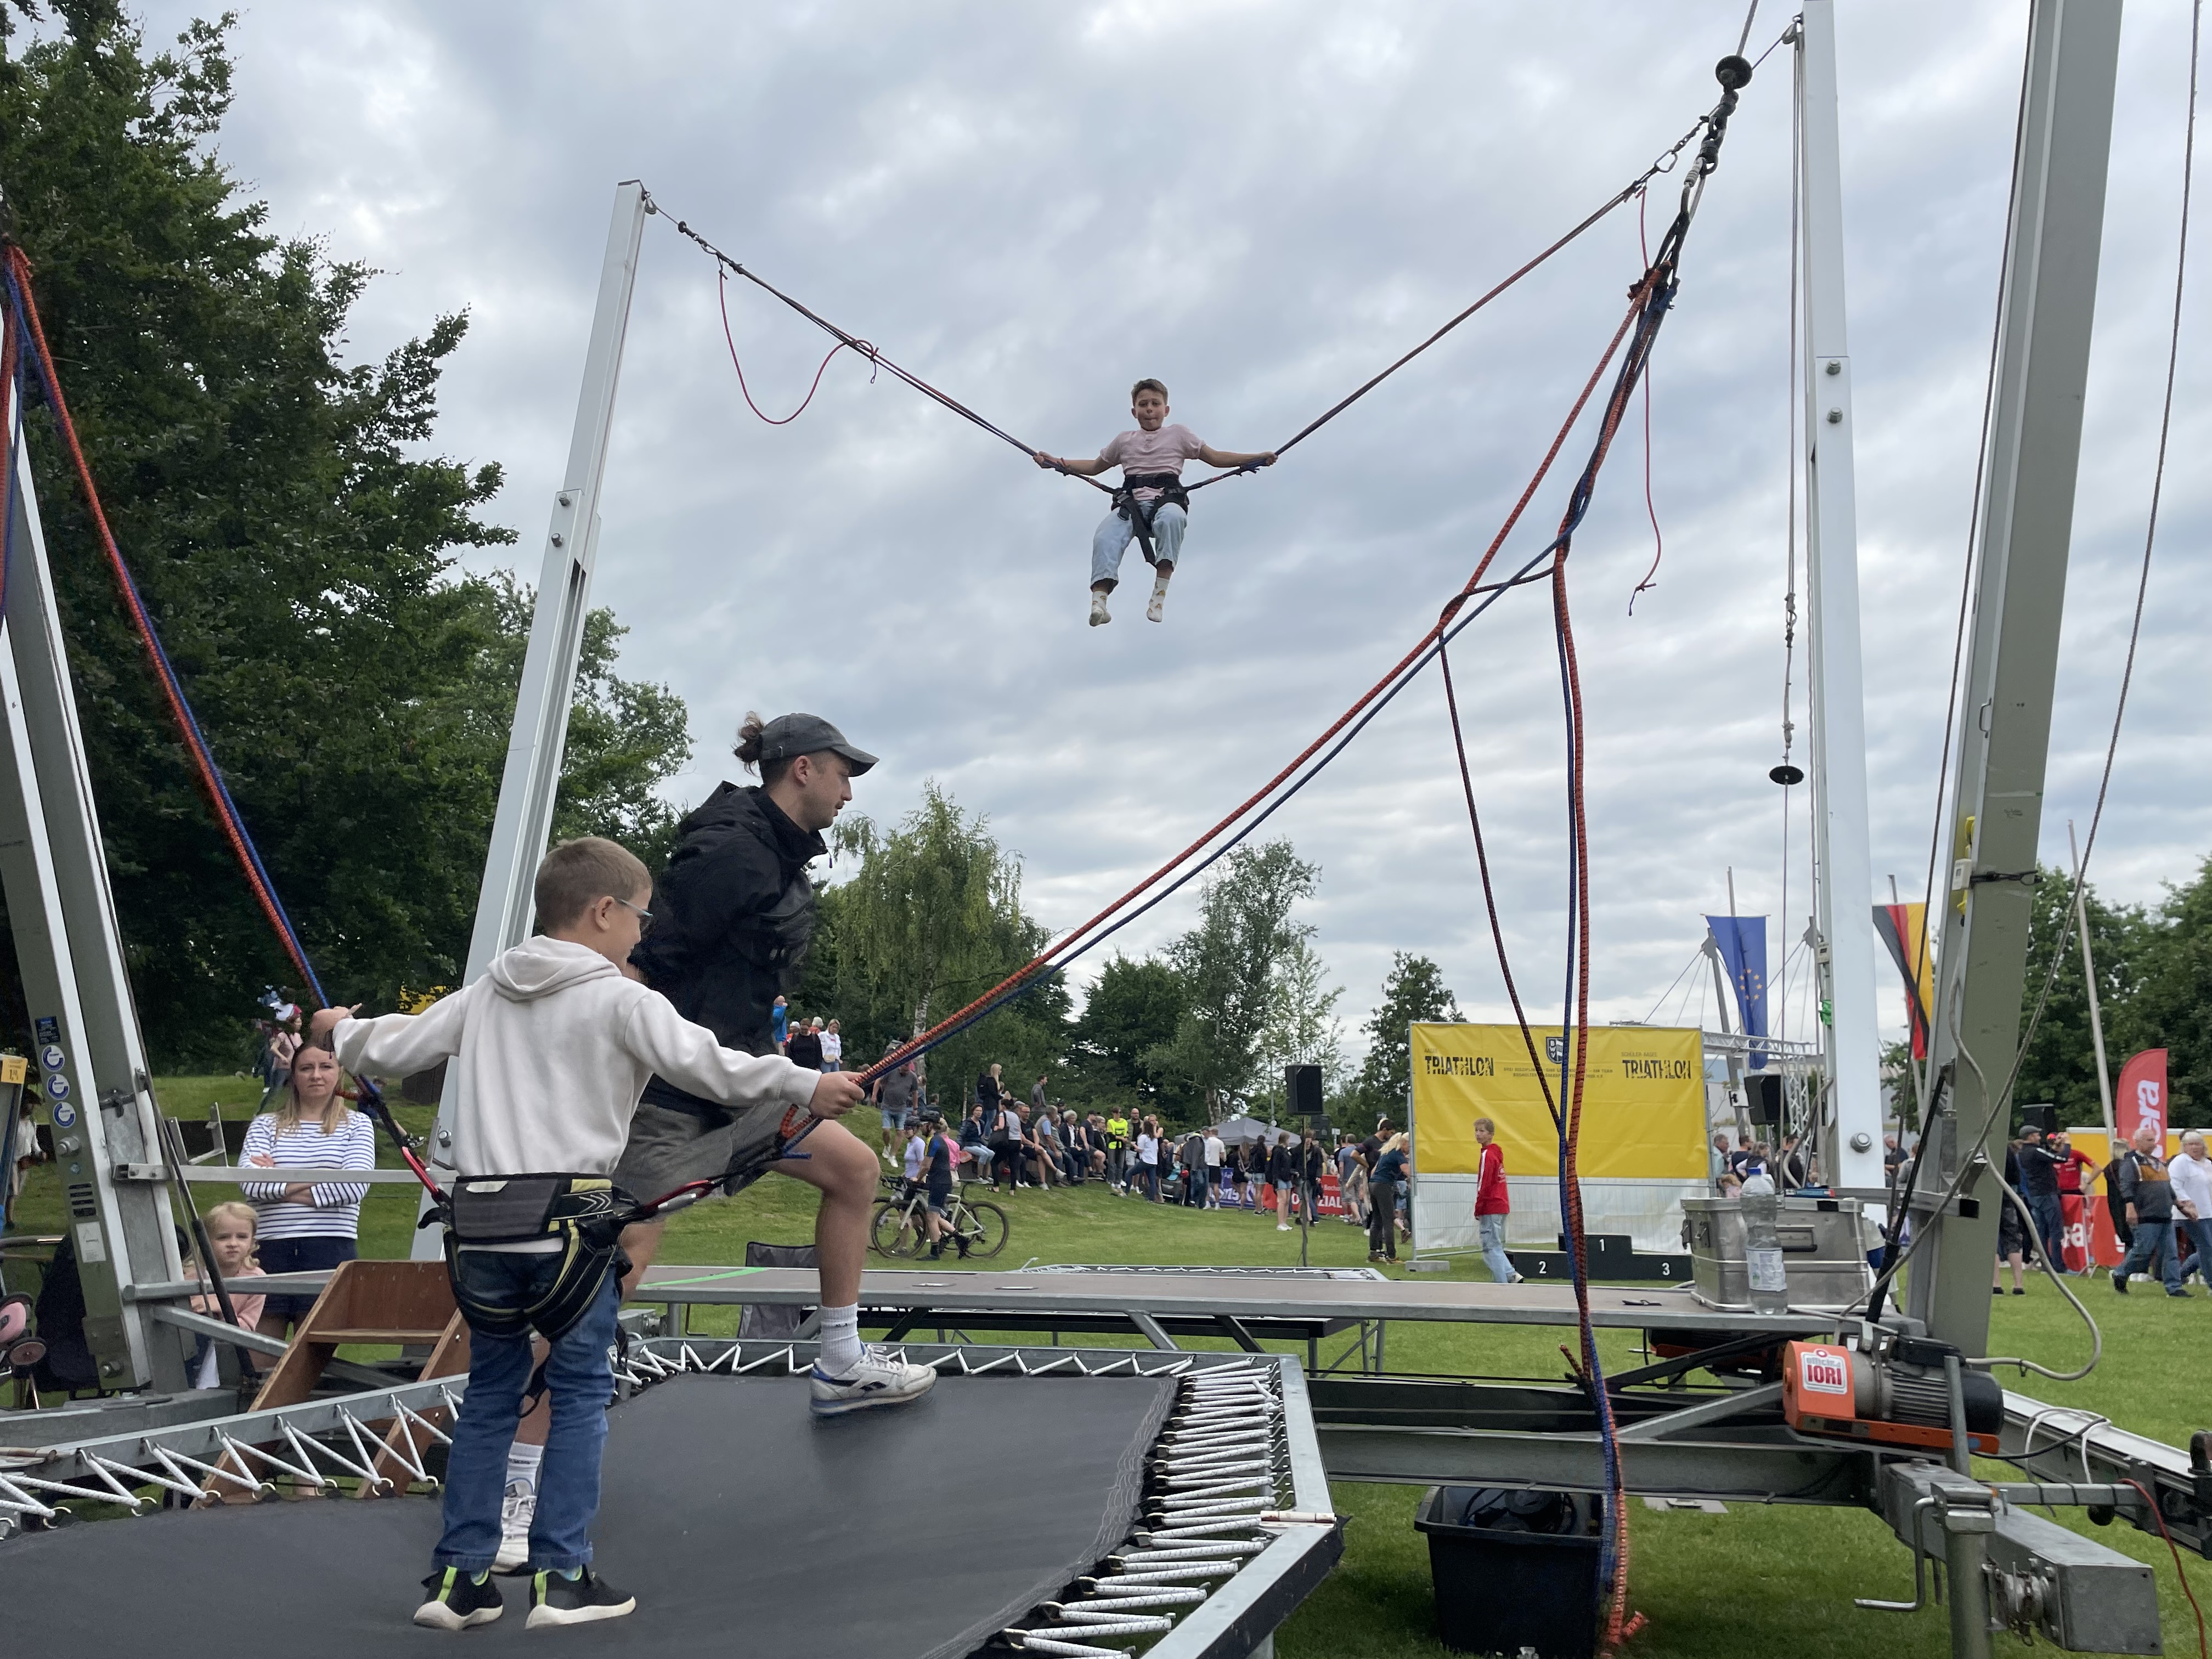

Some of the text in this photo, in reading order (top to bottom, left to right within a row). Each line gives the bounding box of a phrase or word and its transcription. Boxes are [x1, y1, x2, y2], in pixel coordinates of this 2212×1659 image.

[1425, 1056, 1494, 1076] TRIATHLON
[1622, 1059, 1691, 1079] TRIATHLON
[1599, 1238, 1605, 1252] 1
[1538, 1261, 1547, 1274] 2
[1661, 1262, 1671, 1276] 3
[1807, 1364, 1842, 1386] IORI
